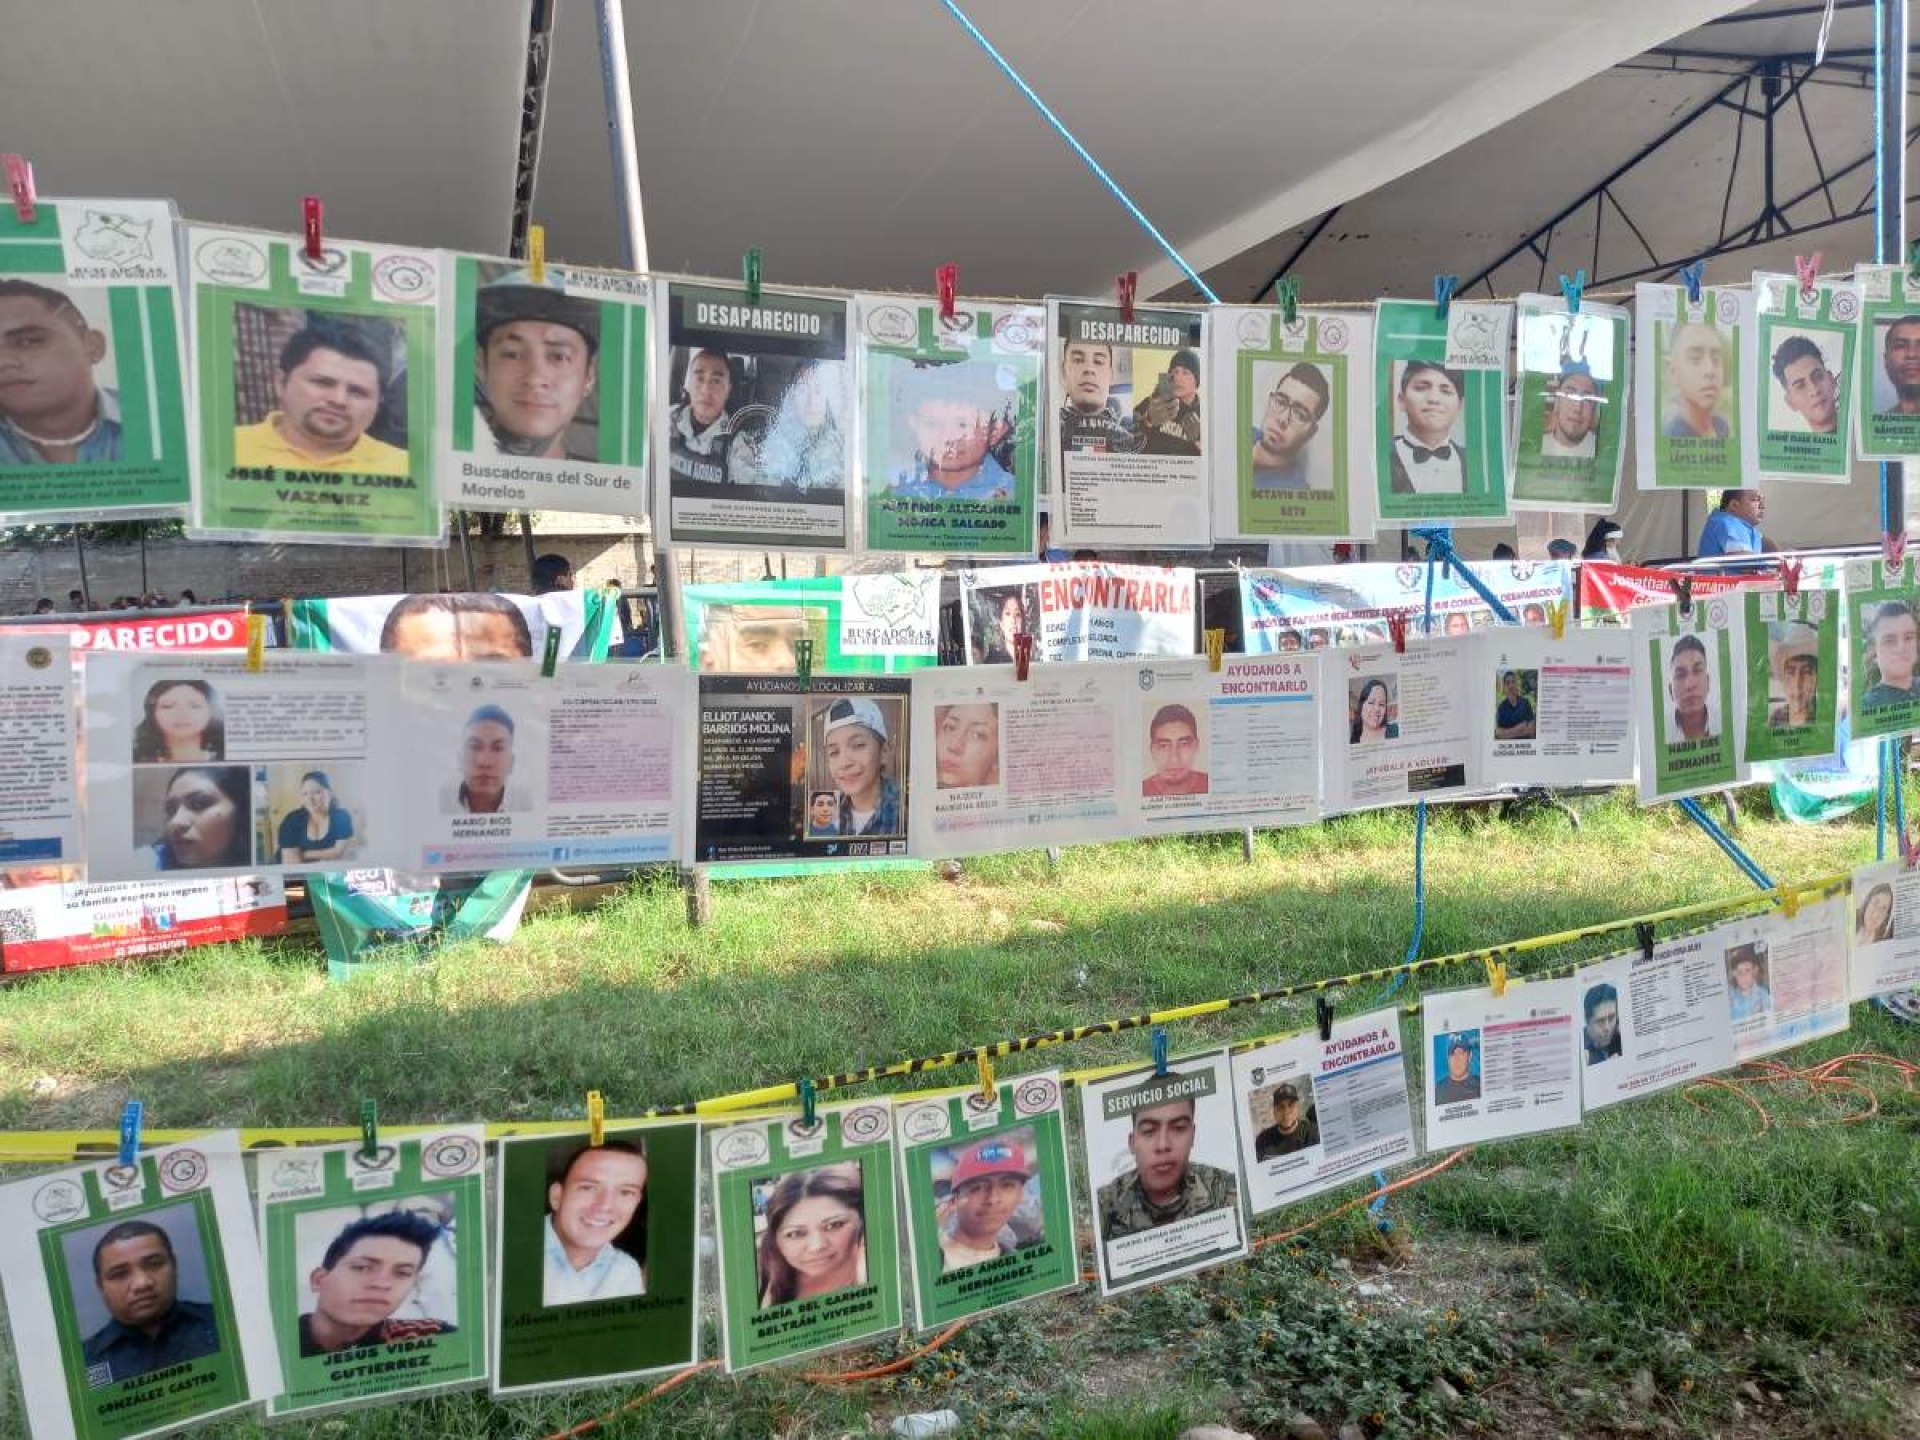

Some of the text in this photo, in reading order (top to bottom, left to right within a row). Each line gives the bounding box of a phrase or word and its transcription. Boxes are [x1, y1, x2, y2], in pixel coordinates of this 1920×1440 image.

[697, 303, 820, 334] DESAPARECIDO
[1081, 320, 1180, 345] DESAPARECIDO
[226, 466, 275, 482] JOSÉ
[284, 471, 343, 485] DAVID
[462, 463, 630, 489] Buscadoras del Sur de
[462, 483, 525, 500] Morelos
[951, 519, 1007, 529] SALGADO
[1041, 575, 1191, 614] ENCONTRARLA
[70, 618, 234, 648] PARECIDO
[1294, 664, 1301, 675] A
[813, 681, 865, 692] LOCALIZAR
[1221, 679, 1308, 694] ENCONTRARLO
[703, 723, 791, 733] BARRIOS MOLINA
[452, 817, 485, 827] MARIO
[81, 896, 118, 907] familia
[121, 892, 155, 903] espera
[158, 890, 169, 898] su
[172, 885, 209, 897] regreso
[1381, 1028, 1389, 1039] A
[1322, 1040, 1396, 1071] ENCONTRARLO
[1108, 1075, 1208, 1113] SERVICIO SOCIAL
[751, 1285, 878, 1326] MARÍA DEL CARMEN
[757, 1314, 817, 1339] BELTRÁN
[386, 1338, 438, 1355] VIDAL
[122, 1362, 193, 1392] ALEJANDRO
[331, 1354, 432, 1382] GUTIERREZ
[168, 1370, 218, 1394] CASTRO
